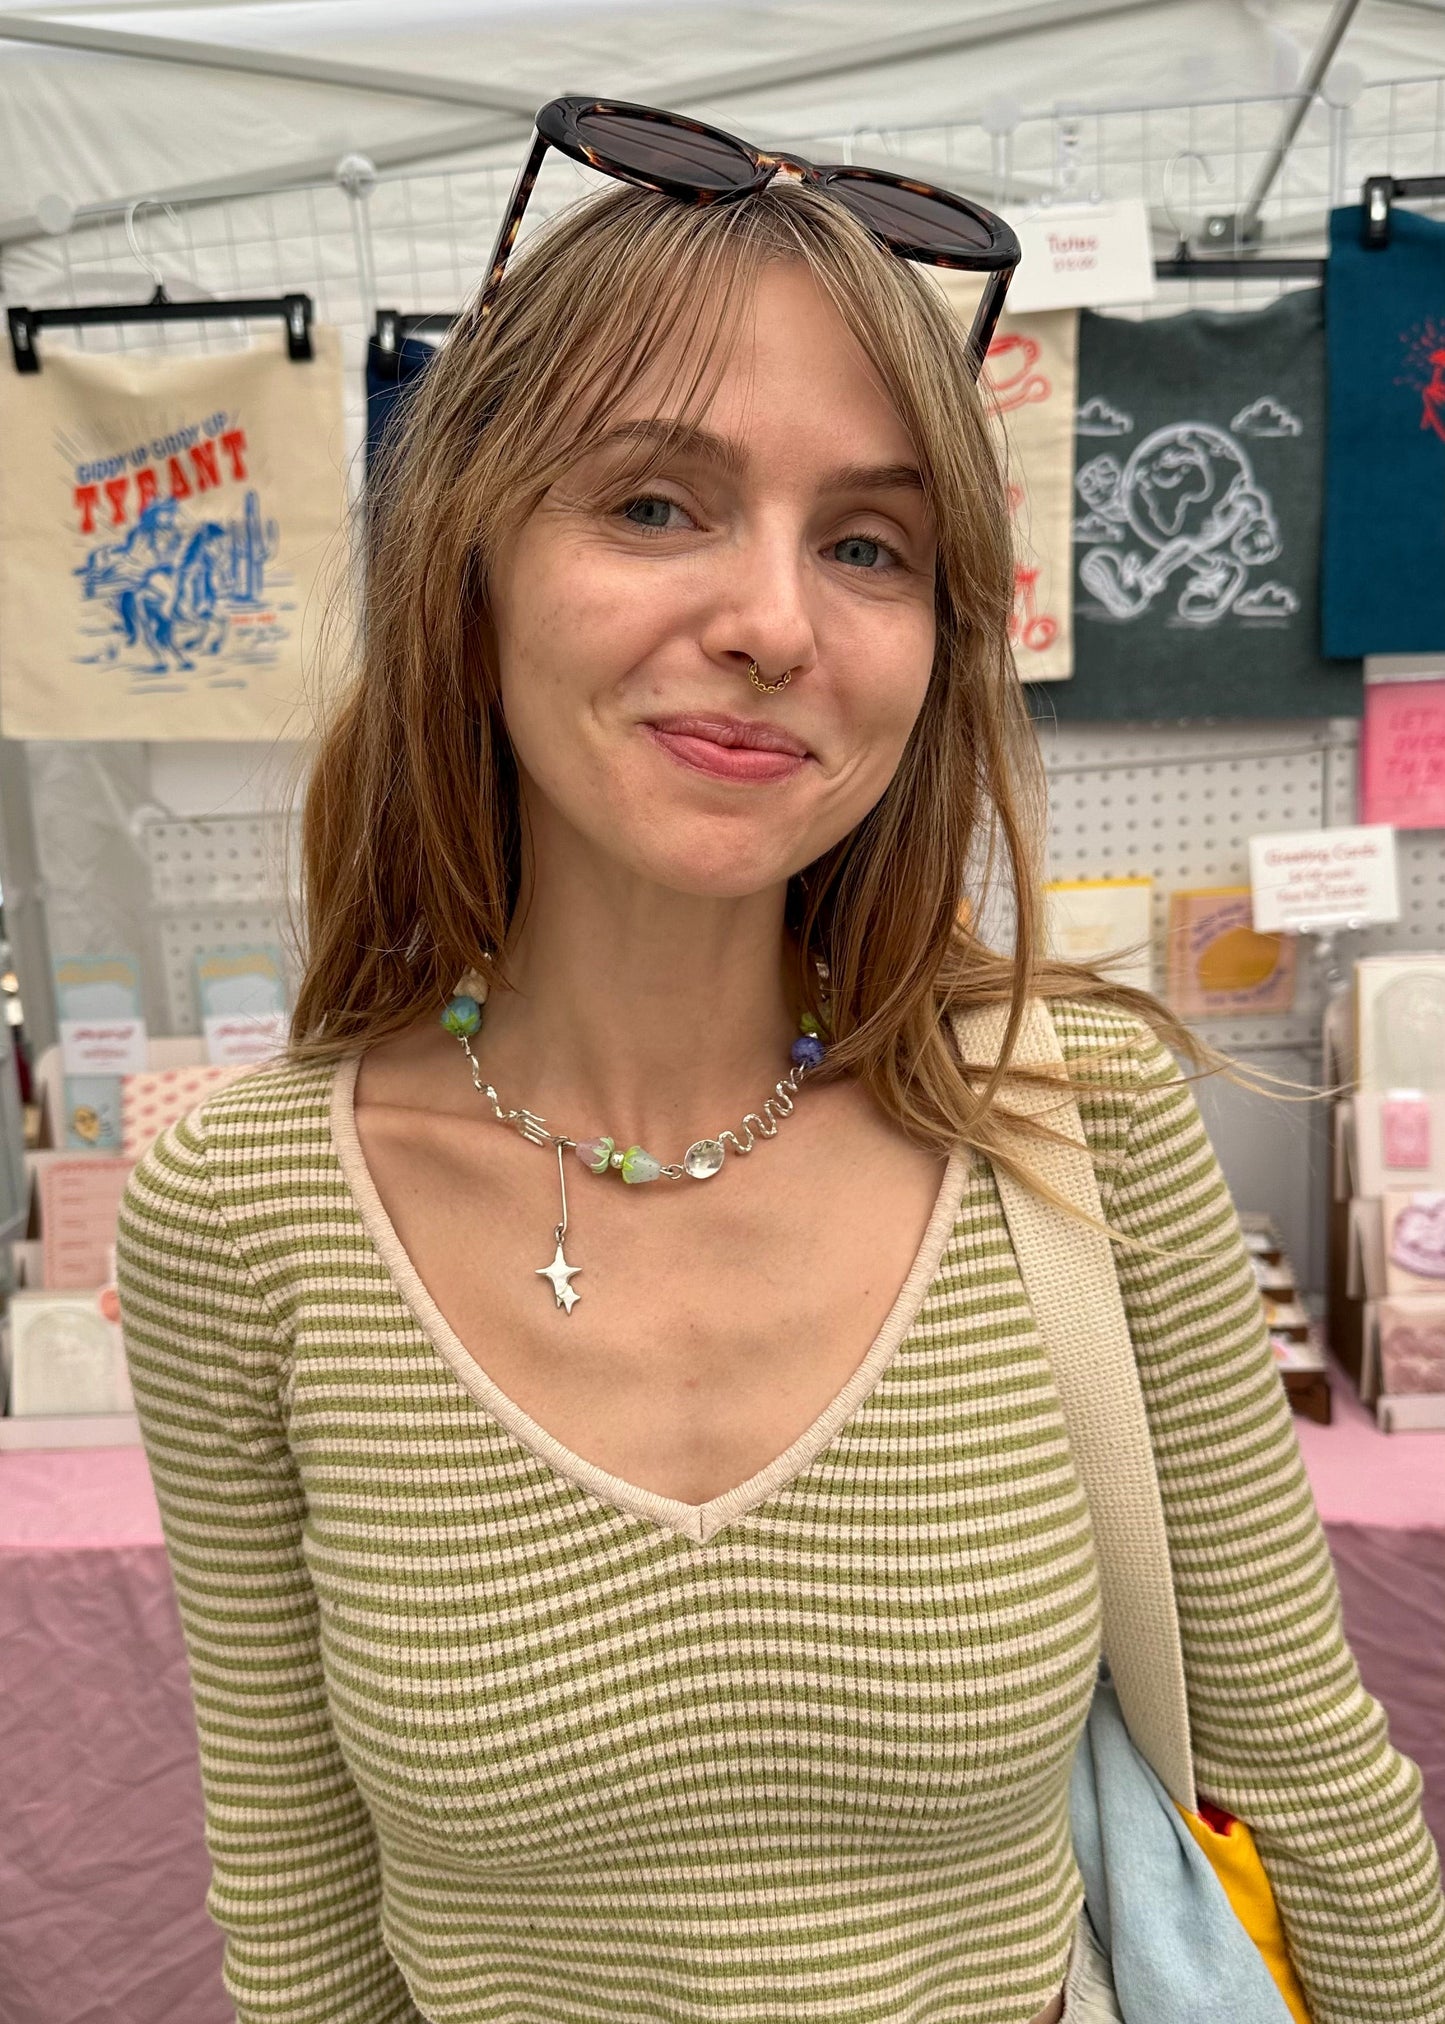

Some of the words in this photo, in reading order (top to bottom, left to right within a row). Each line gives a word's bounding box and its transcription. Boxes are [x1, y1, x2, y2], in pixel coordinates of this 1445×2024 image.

[73, 428, 247, 534] TYRANT
[76, 453, 127, 484] GIDDY
[151, 425, 199, 460] GIDDY
[202, 411, 228, 437] UP
